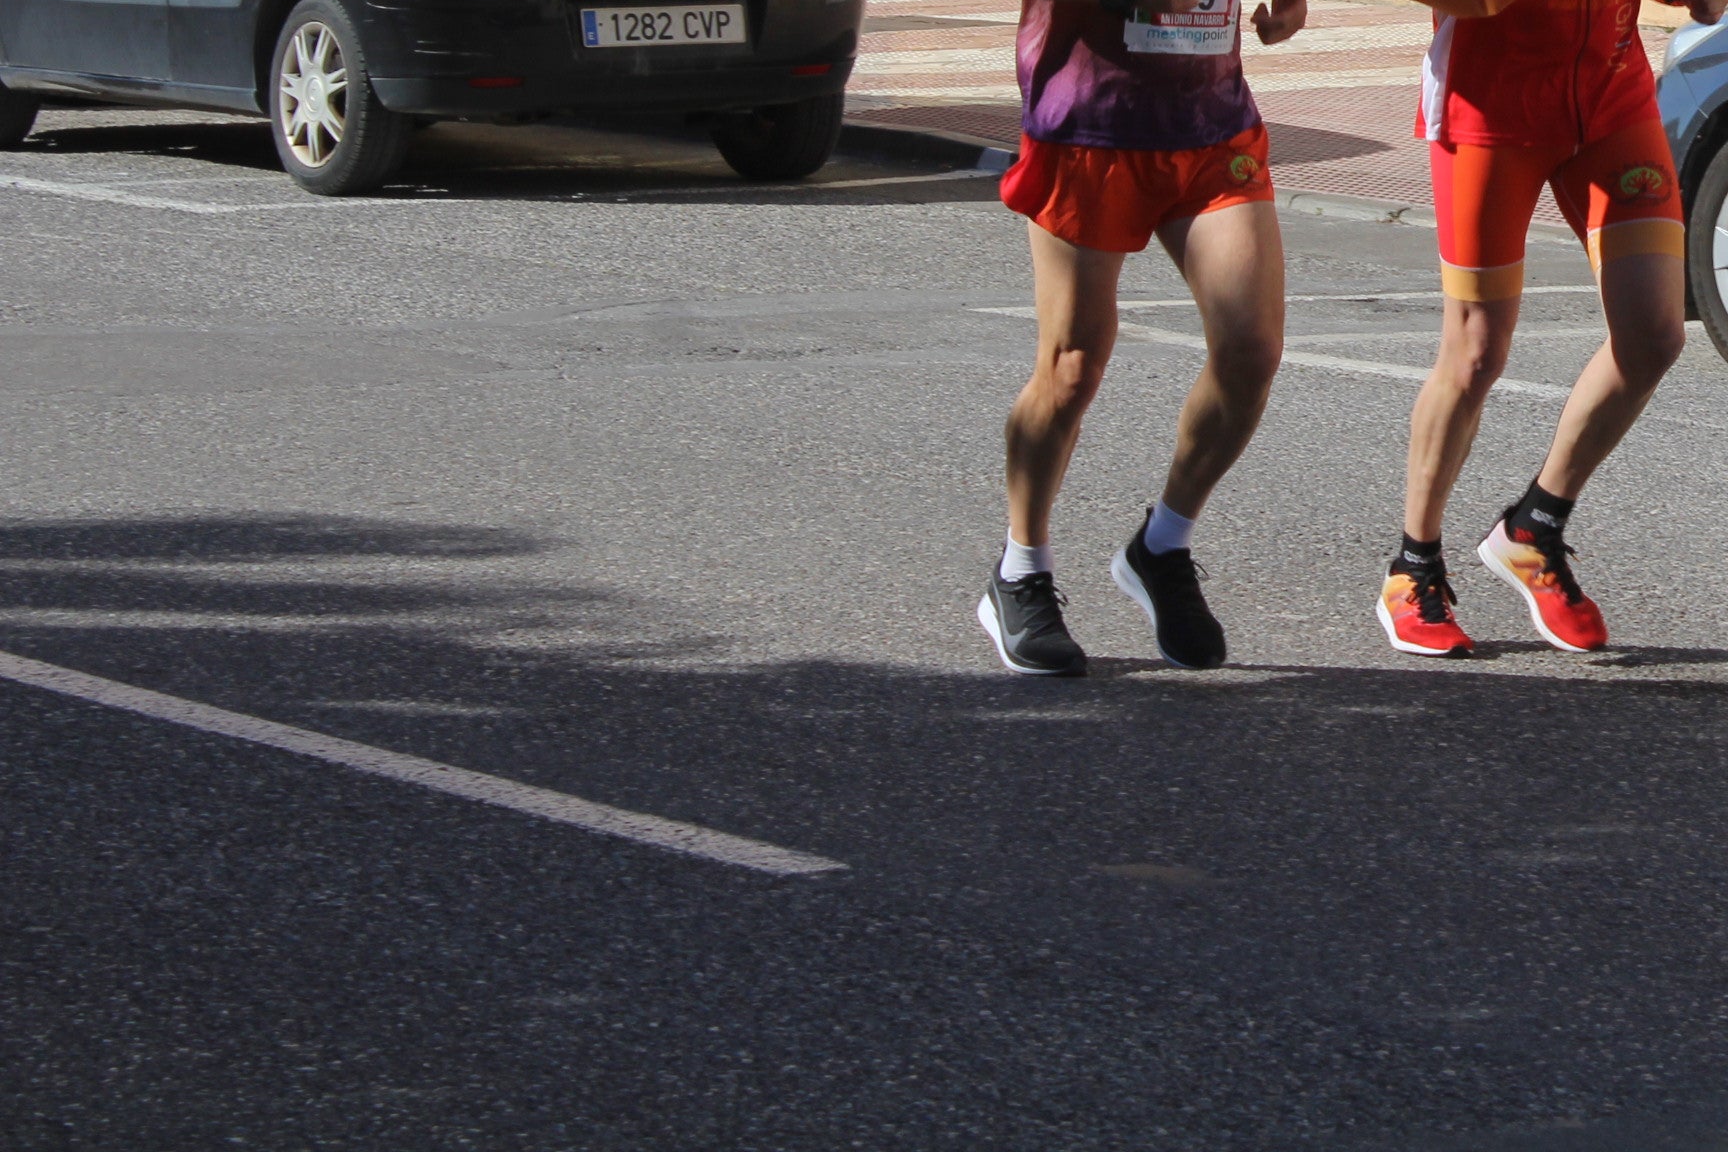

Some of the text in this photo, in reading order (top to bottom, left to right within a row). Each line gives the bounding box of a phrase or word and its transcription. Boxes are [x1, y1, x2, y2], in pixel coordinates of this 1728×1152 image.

[611, 11, 674, 41] 1282
[684, 10, 731, 38] CVP
[1160, 13, 1225, 25] ANTONIO NAVARRO
